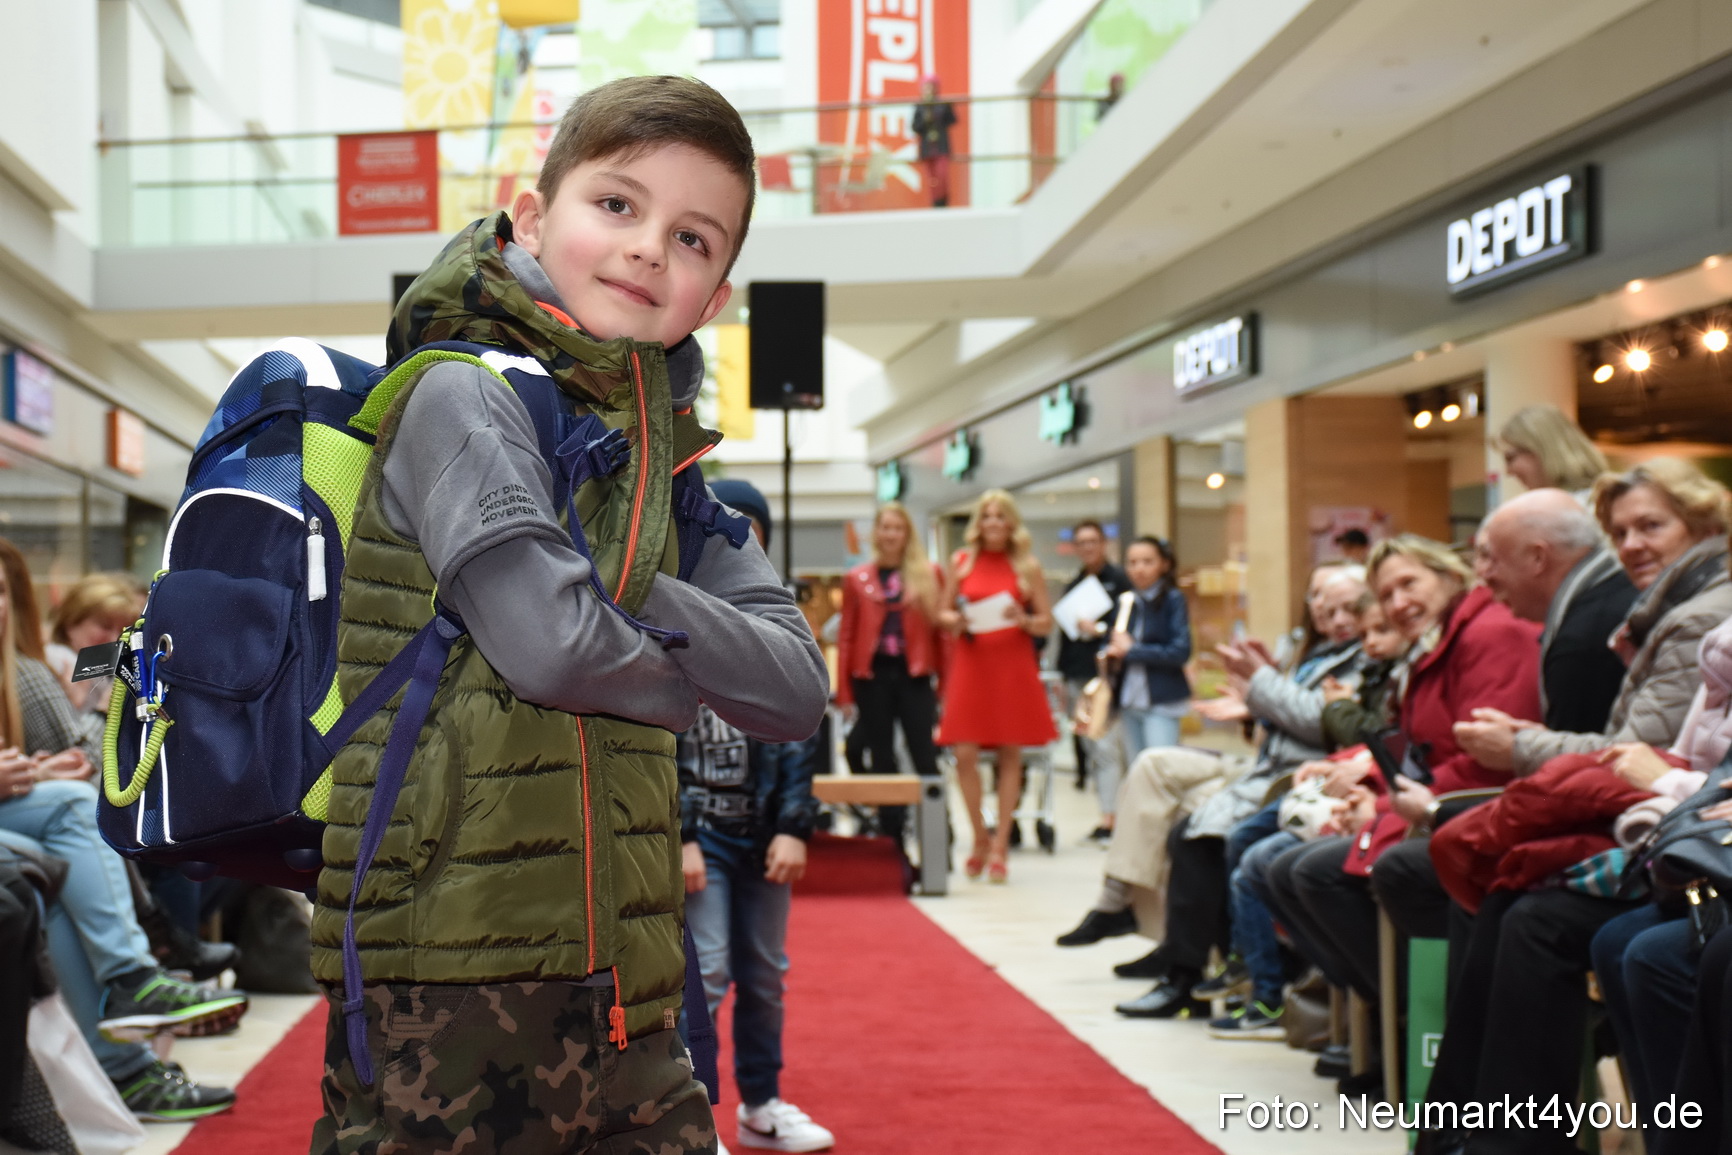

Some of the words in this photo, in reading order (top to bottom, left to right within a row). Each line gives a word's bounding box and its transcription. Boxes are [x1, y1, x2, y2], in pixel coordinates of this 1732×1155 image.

[1447, 174, 1571, 284] DEPOT
[1173, 316, 1243, 389] DEPOT
[478, 488, 500, 508] CITY
[480, 494, 538, 517] UNDERGRO
[481, 505, 538, 526] MOVEMENT
